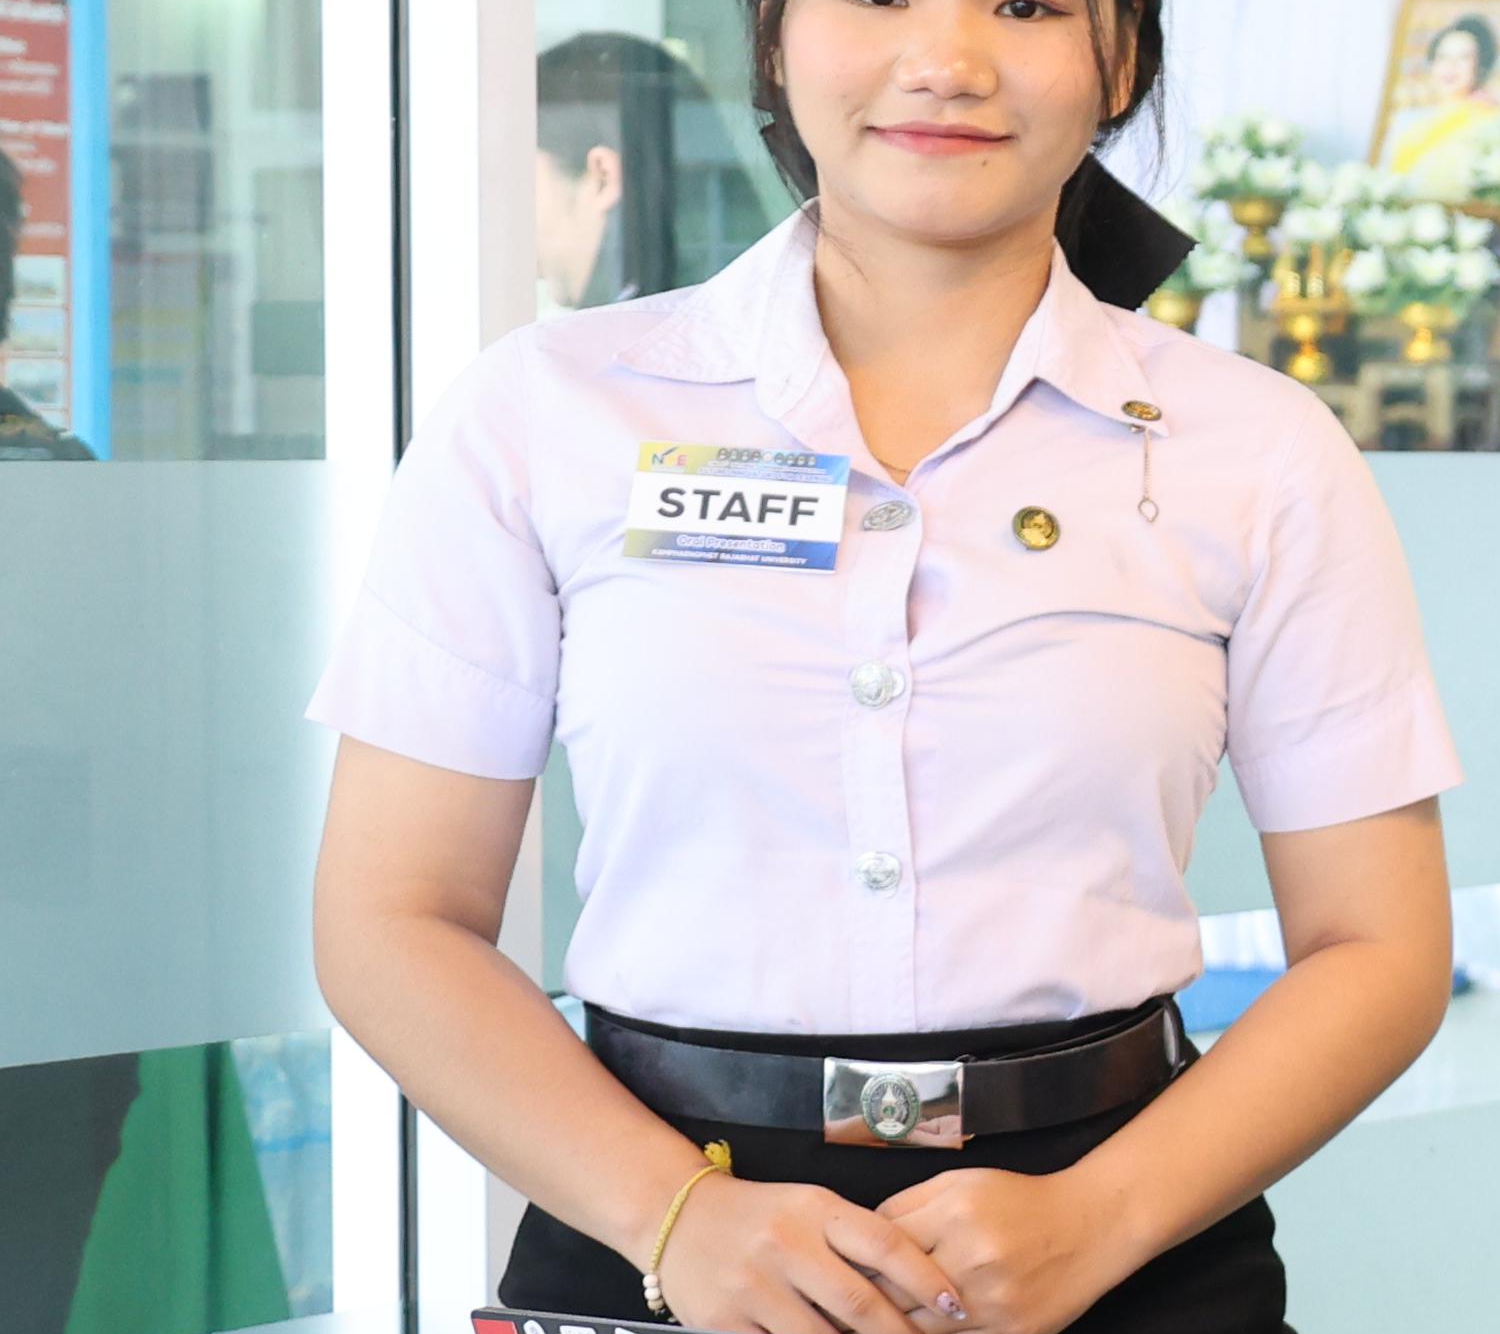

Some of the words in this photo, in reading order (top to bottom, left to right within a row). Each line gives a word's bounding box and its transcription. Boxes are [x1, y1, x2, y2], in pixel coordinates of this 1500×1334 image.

[657, 487, 820, 526] STAFF
[676, 534, 705, 548] Oral
[706, 536, 787, 553] Presentation
